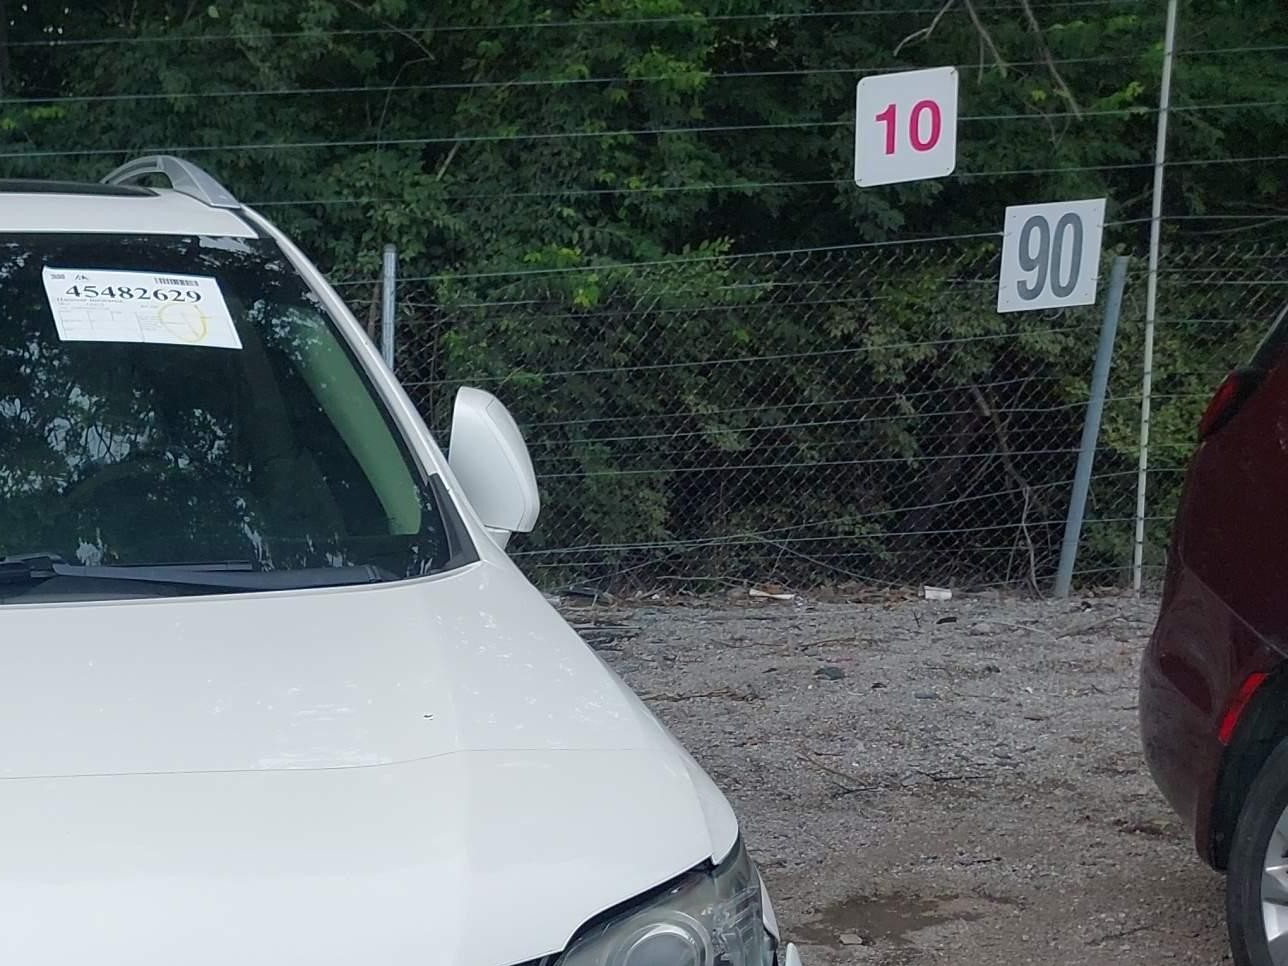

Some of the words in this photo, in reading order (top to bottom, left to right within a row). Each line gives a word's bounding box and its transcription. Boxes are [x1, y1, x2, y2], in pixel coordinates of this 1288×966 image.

[875, 99, 942, 155] 10
[1016, 212, 1084, 301] 90
[65, 285, 202, 303] 45482629
